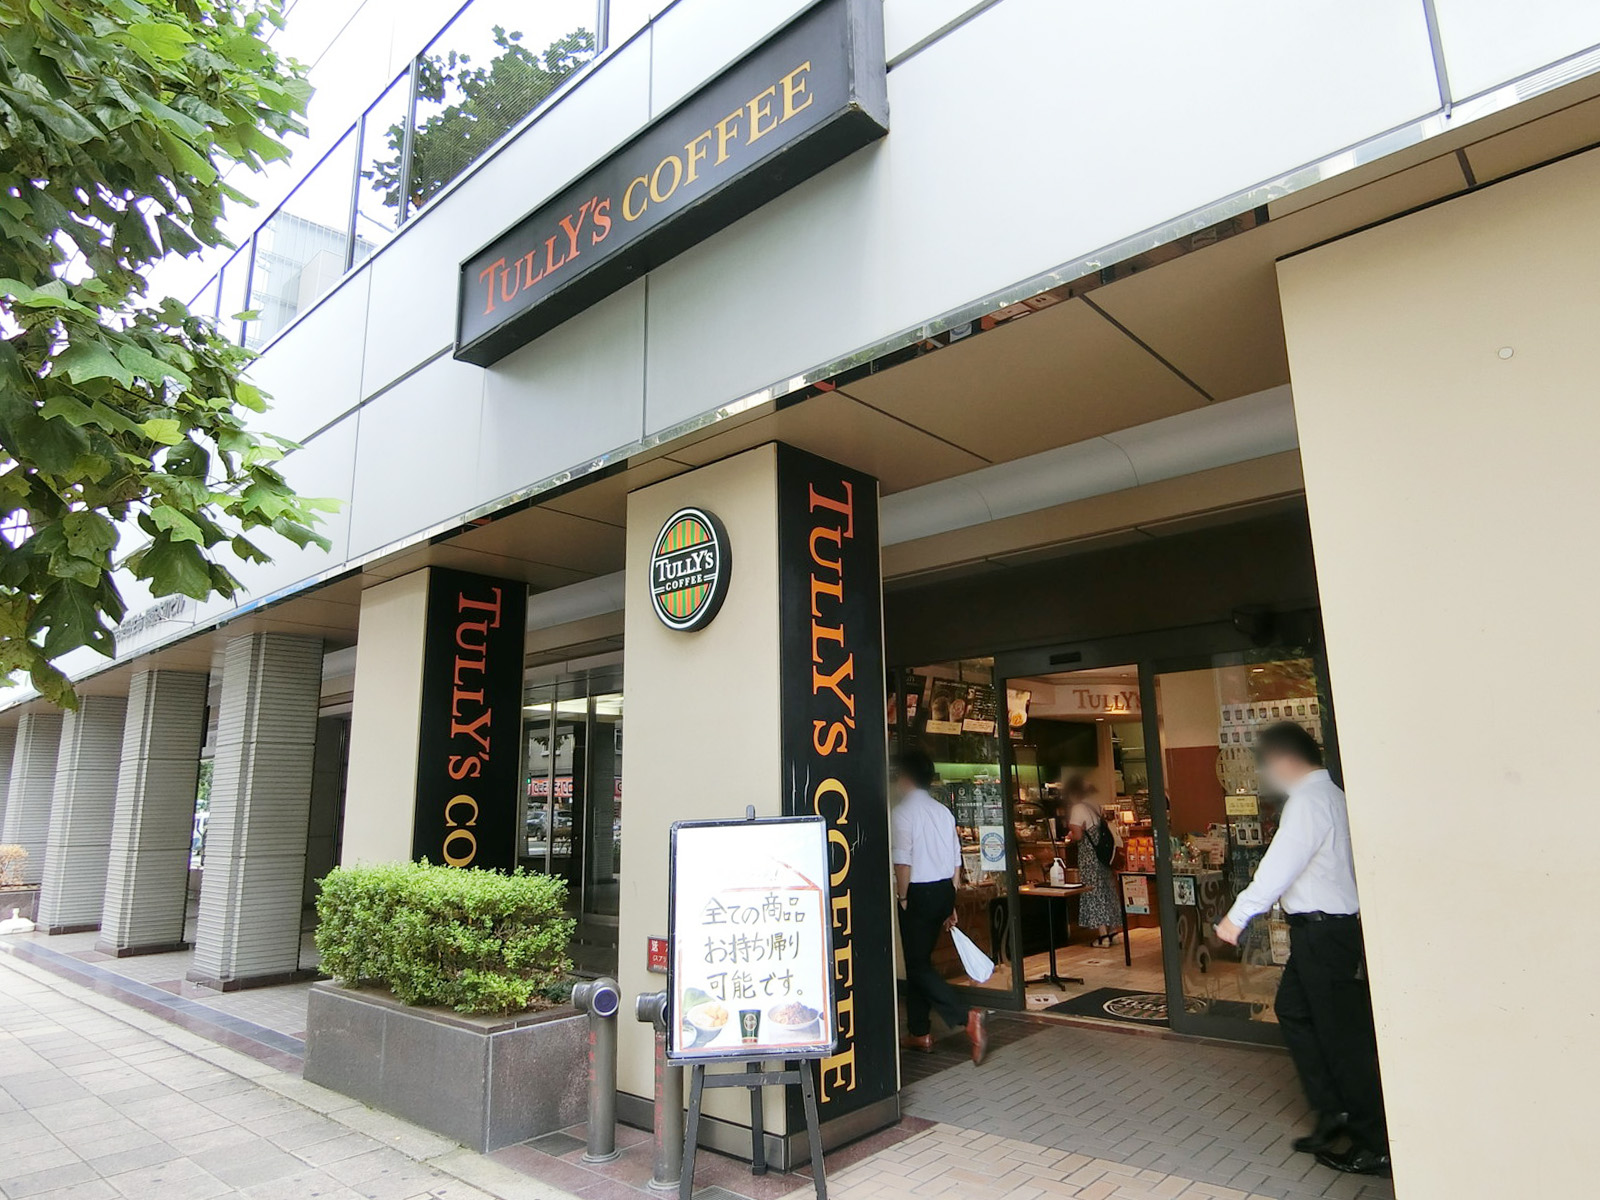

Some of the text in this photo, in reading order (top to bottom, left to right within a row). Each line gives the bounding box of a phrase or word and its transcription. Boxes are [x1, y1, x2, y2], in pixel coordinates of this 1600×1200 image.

[479, 60, 814, 316] TULLY'S COFFEE
[656, 549, 714, 582] TULLY'S
[665, 574, 703, 591] COFFEE
[808, 480, 856, 757] TULLY'S
[448, 587, 502, 781] TULLY'S
[701, 891, 805, 925] 全ての商品
[704, 930, 800, 964] お持ち帰り
[707, 968, 803, 1001] 可能です。
